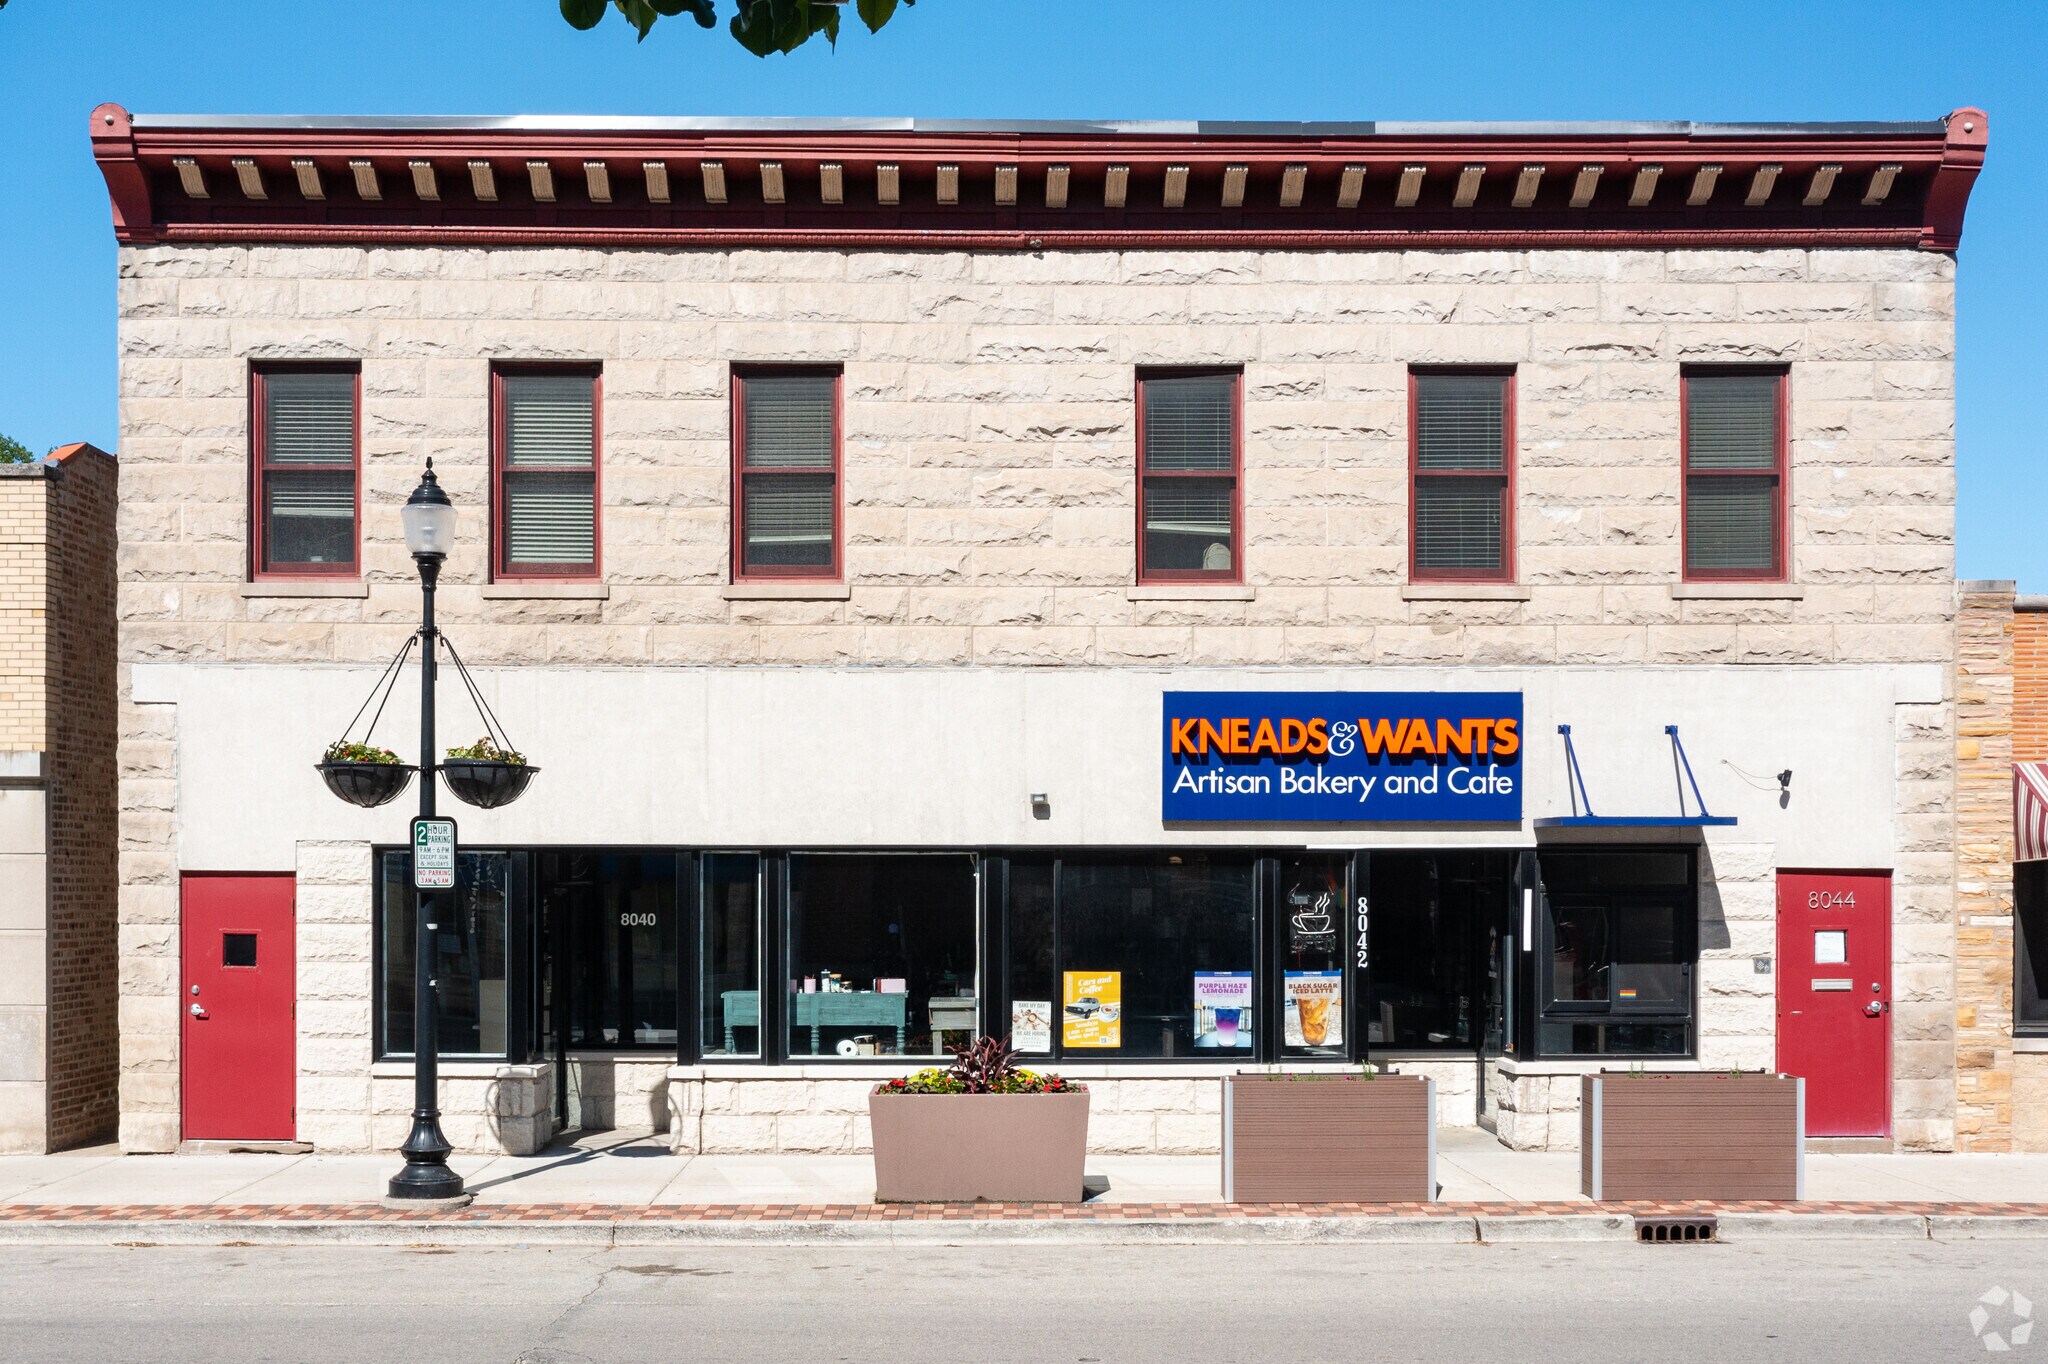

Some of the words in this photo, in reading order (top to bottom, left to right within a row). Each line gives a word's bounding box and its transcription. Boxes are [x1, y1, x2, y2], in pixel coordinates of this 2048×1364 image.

[1171, 718, 1329, 756] KNEADS
[1327, 721, 1358, 756] &
[1358, 718, 1520, 756] WANTS
[1172, 766, 1271, 794] Artisan
[1280, 764, 1377, 802] Bakery
[1384, 764, 1438, 794] and
[1447, 764, 1513, 794] Cafe
[418, 826, 427, 843] 2
[427, 825, 448, 834] HOUR
[1808, 891, 1856, 909] 8044
[620, 913, 656, 926] 8040
[1357, 896, 1368, 968] 8042
[1078, 978, 1097, 987] Cars
[1097, 975, 1112, 984] and
[1079, 985, 1103, 994] Coffee
